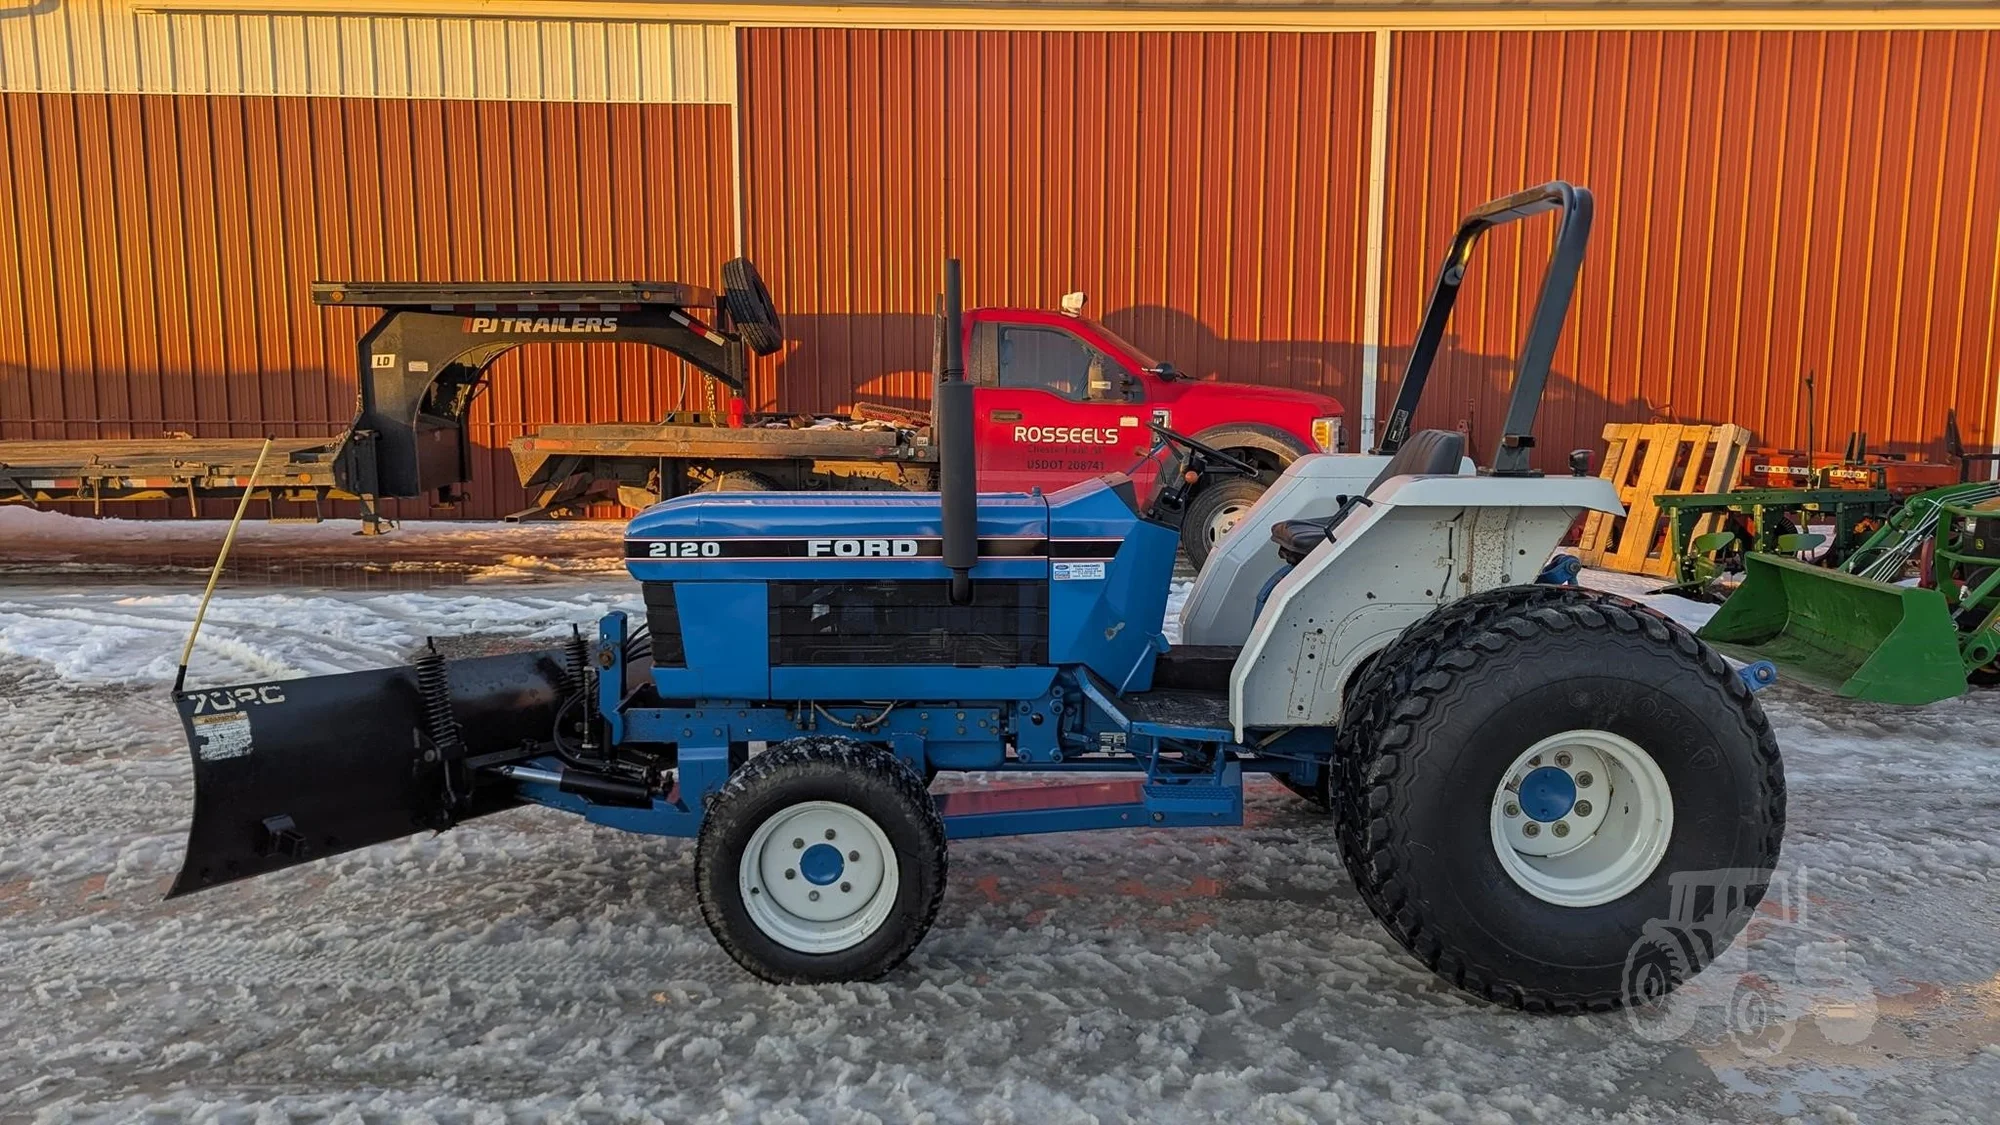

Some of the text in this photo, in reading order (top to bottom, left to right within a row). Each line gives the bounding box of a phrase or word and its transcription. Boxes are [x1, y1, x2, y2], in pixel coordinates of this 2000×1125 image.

[471, 317, 618, 334] PJ TRAILERS
[376, 356, 391, 367] LD
[1014, 426, 1119, 444] ROSSEEL'S
[1027, 460, 1063, 470] USDOT
[649, 540, 918, 557] 2120 FORD
